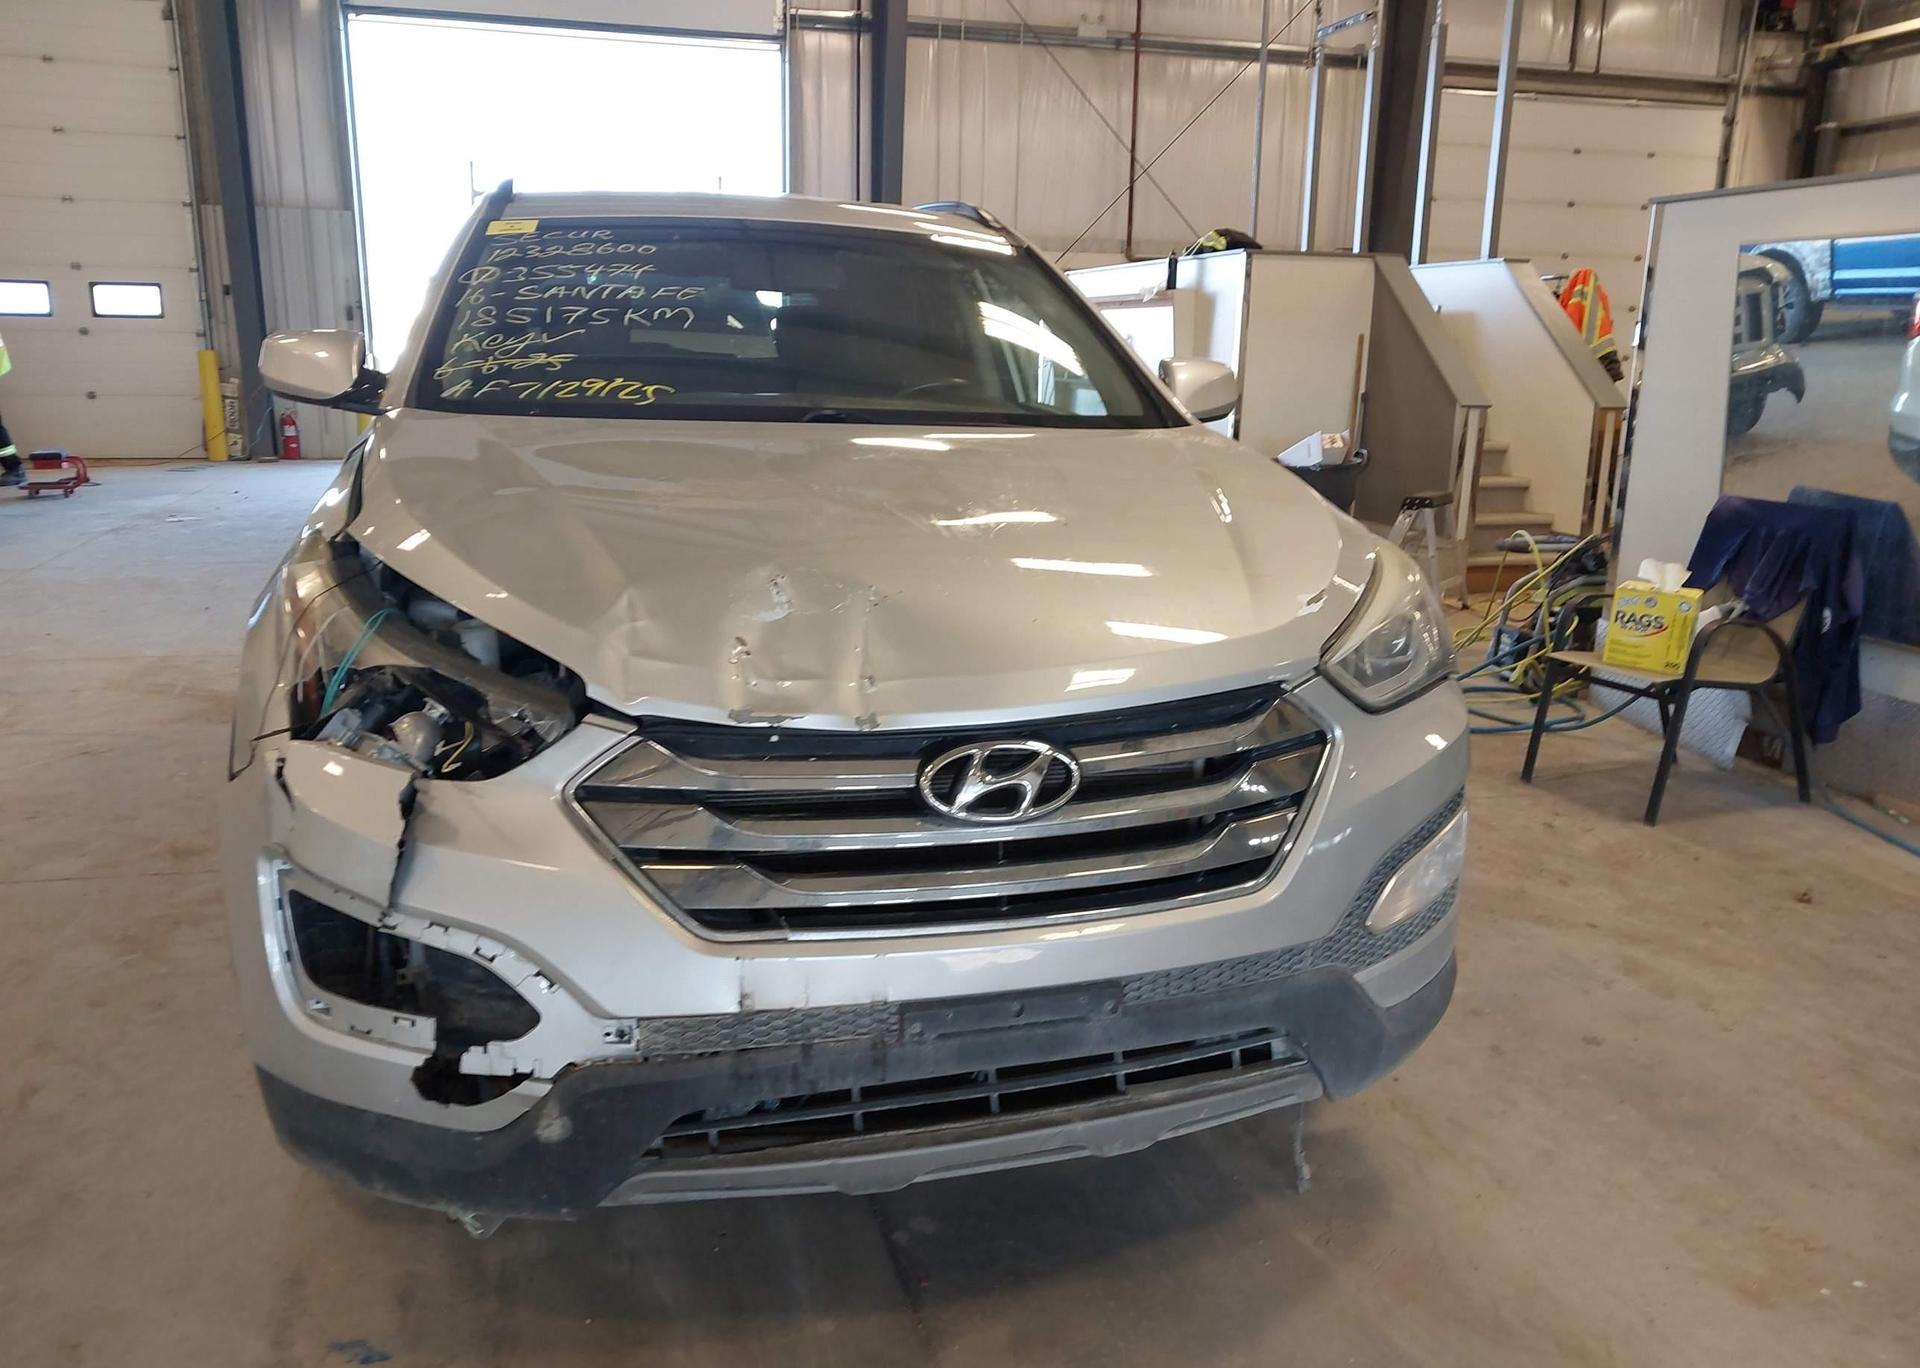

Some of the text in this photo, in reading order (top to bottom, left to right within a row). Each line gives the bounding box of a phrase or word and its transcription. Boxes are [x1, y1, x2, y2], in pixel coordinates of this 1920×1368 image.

[513, 284, 646, 301] SANTA
[651, 285, 706, 300] FE
[1614, 610, 1665, 630] RAGS
